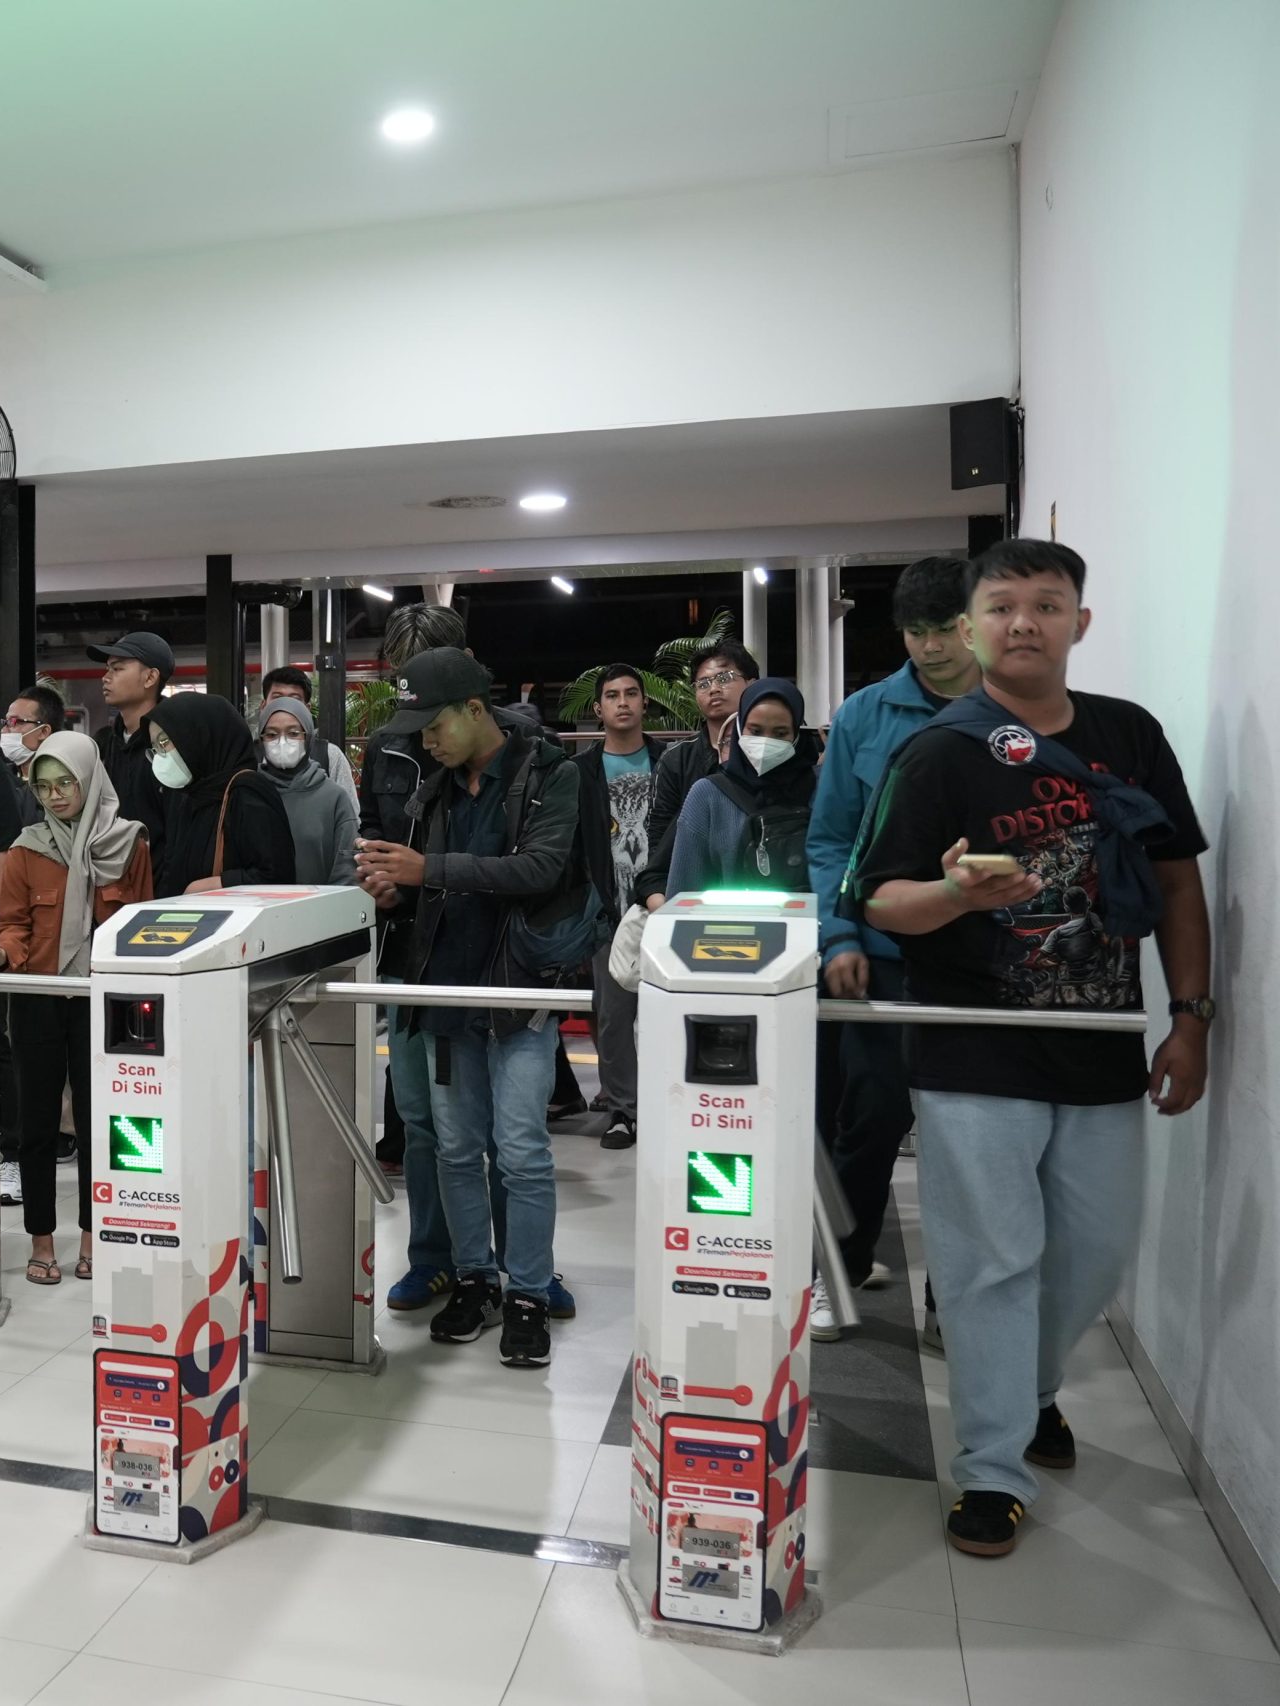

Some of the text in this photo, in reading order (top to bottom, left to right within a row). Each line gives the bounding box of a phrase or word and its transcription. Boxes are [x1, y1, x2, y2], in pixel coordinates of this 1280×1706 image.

[118, 1062, 156, 1076] Scan
[112, 1080, 162, 1095] Di Sini
[699, 1093, 745, 1109] Scan
[691, 1113, 753, 1130] Di Sini
[118, 1189, 180, 1203] C-ACCESS
[119, 1201, 181, 1211] #TemanPerjalanan
[108, 1218, 140, 1226] Download
[697, 1235, 773, 1250] C-ACCESS
[697, 1248, 773, 1259] #TemanPerjalanan
[692, 1537, 731, 1550] 939-036
